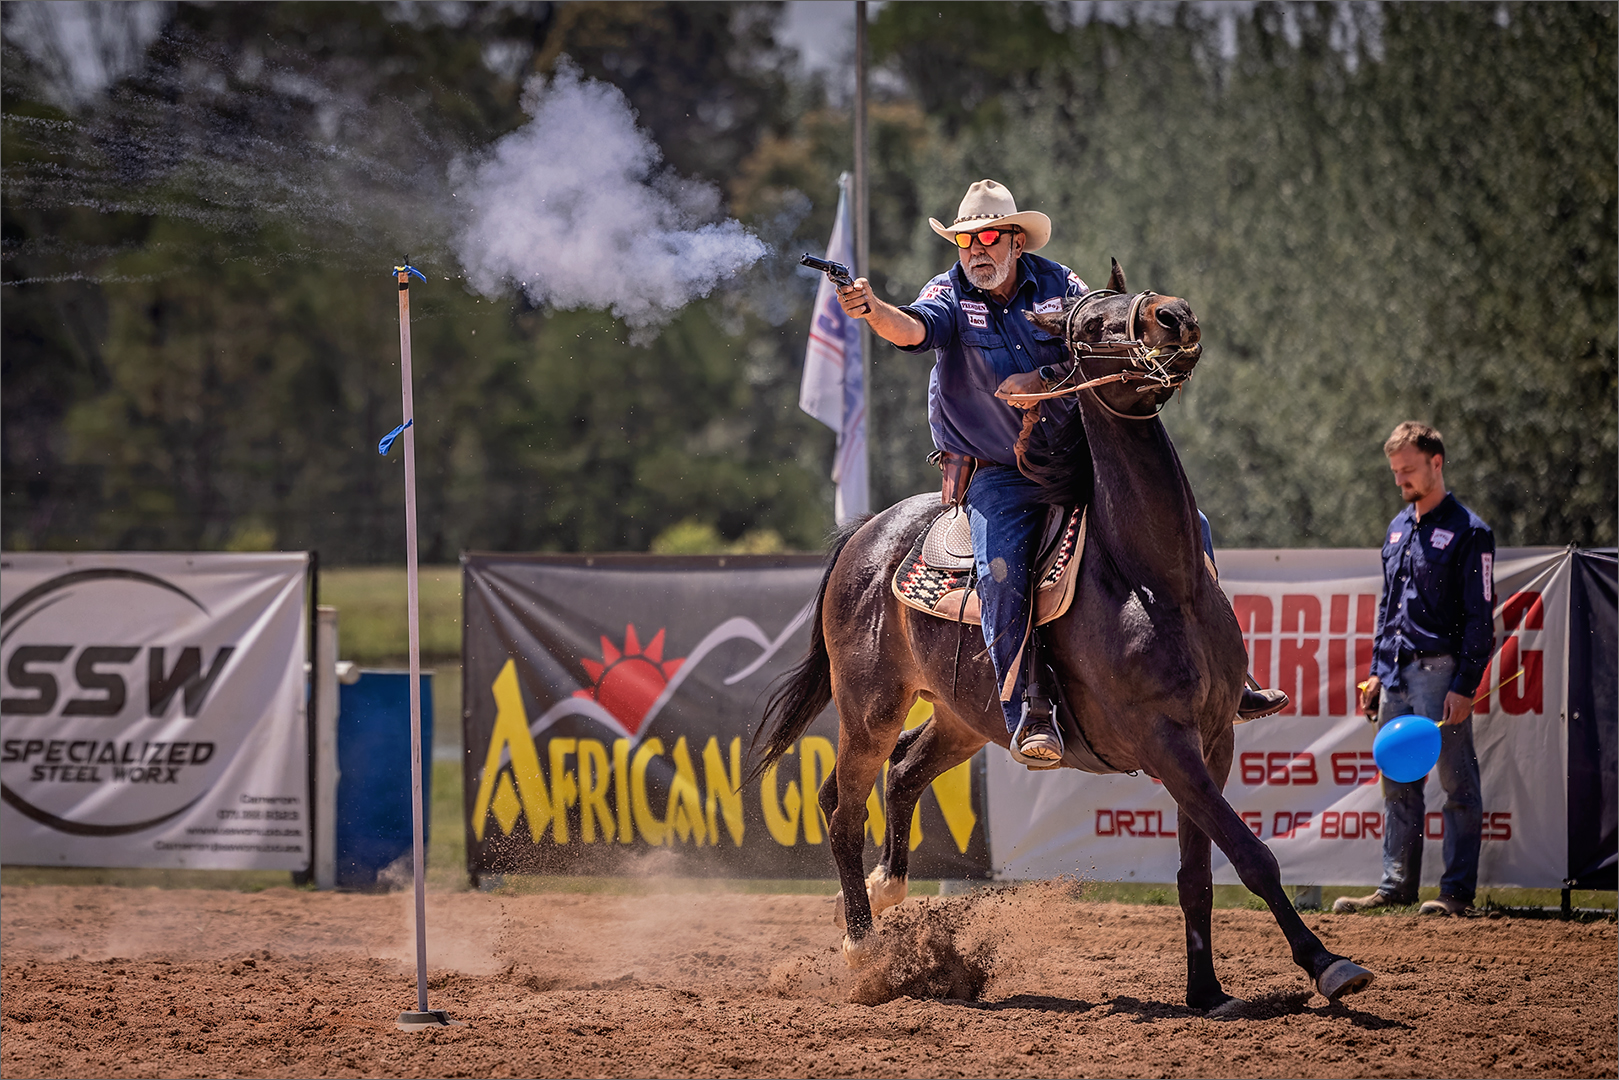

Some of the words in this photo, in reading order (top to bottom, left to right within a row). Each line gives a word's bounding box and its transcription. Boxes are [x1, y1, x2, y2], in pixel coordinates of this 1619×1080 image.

[970, 315, 985, 325] Jaco
[2, 646, 235, 718] SSW
[2, 739, 217, 765] SPECIALIZED
[472, 659, 746, 848] AFRICAN
[30, 765, 102, 783] STEEL
[113, 767, 181, 784] WORX
[1240, 752, 1319, 786] 663
[1272, 811, 1313, 839] OF
